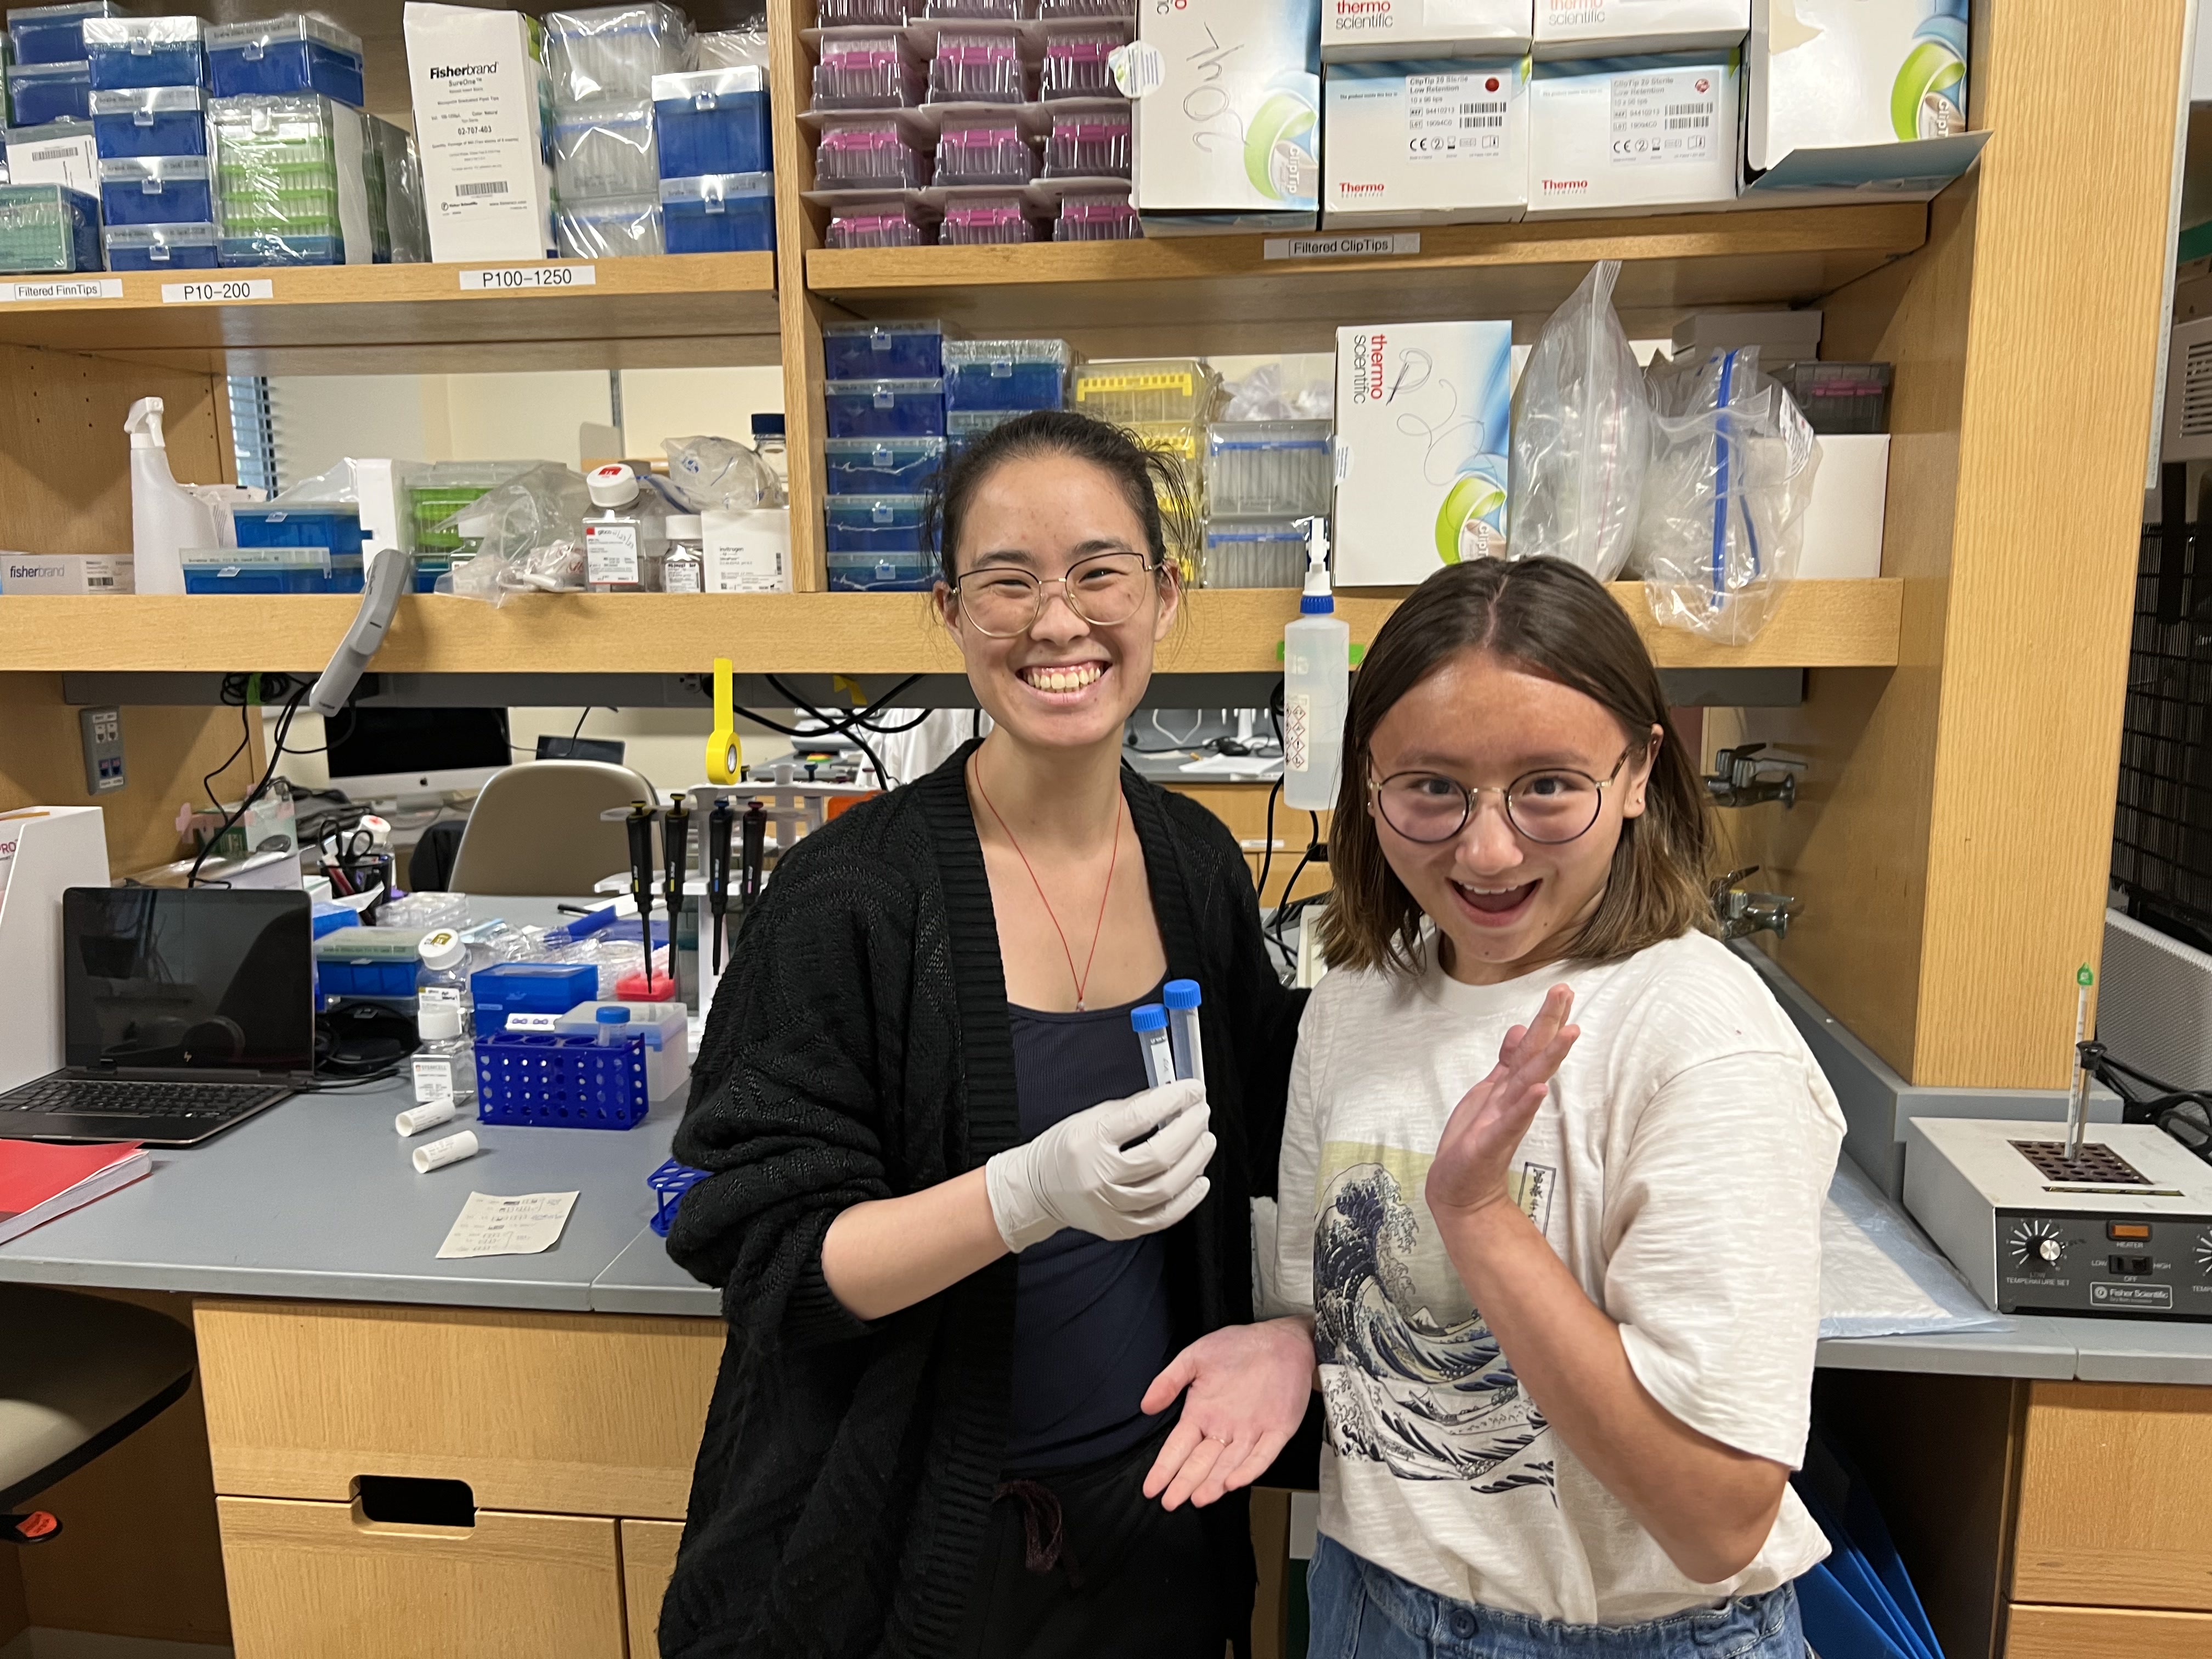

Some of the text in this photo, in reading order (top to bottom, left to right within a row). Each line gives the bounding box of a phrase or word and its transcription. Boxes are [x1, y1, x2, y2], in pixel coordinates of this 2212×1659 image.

[1336, 0, 1390, 14] thermo
[1336, 13, 1393, 30] scientific
[1549, 9, 1605, 26] scientific
[430, 61, 497, 79] Fisherbrand
[1936, 99, 1949, 137] ClipT
[458, 125, 492, 135] 02-707-403
[1286, 145, 1300, 194] ClipTip
[1339, 182, 1385, 192] Thermo
[1542, 179, 1588, 190] Thermo
[1294, 238, 1388, 254] Filtered ClipTips
[483, 268, 572, 287] P100-1250
[18, 284, 98, 297] Filtered FinnTips
[184, 283, 251, 300] P10-200
[1353, 335, 1369, 404] scientific
[1370, 334, 1387, 400] thermo
[1477, 524, 1489, 556] ClipT
[10, 565, 65, 578] fisherbrand
[2006, 1277, 2055, 1285] TEMPERATURE
[2110, 1289, 2169, 1299] Fisher Scientific
